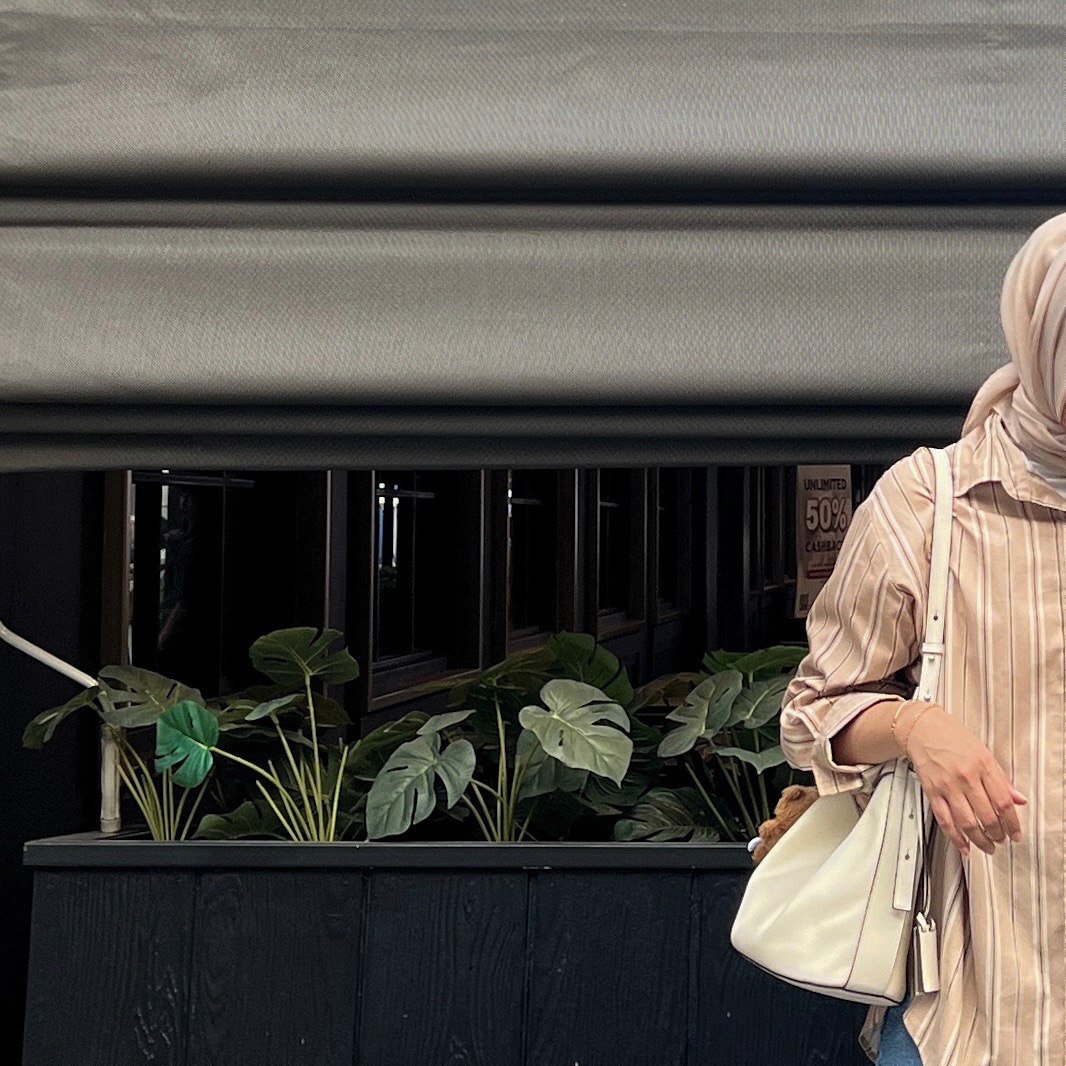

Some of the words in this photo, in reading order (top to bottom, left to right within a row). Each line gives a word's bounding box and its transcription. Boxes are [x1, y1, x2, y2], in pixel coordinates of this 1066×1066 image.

[804, 478, 847, 491] UNLIMITED
[805, 497, 847, 532] 50%
[806, 540, 843, 552] CASHBAC
